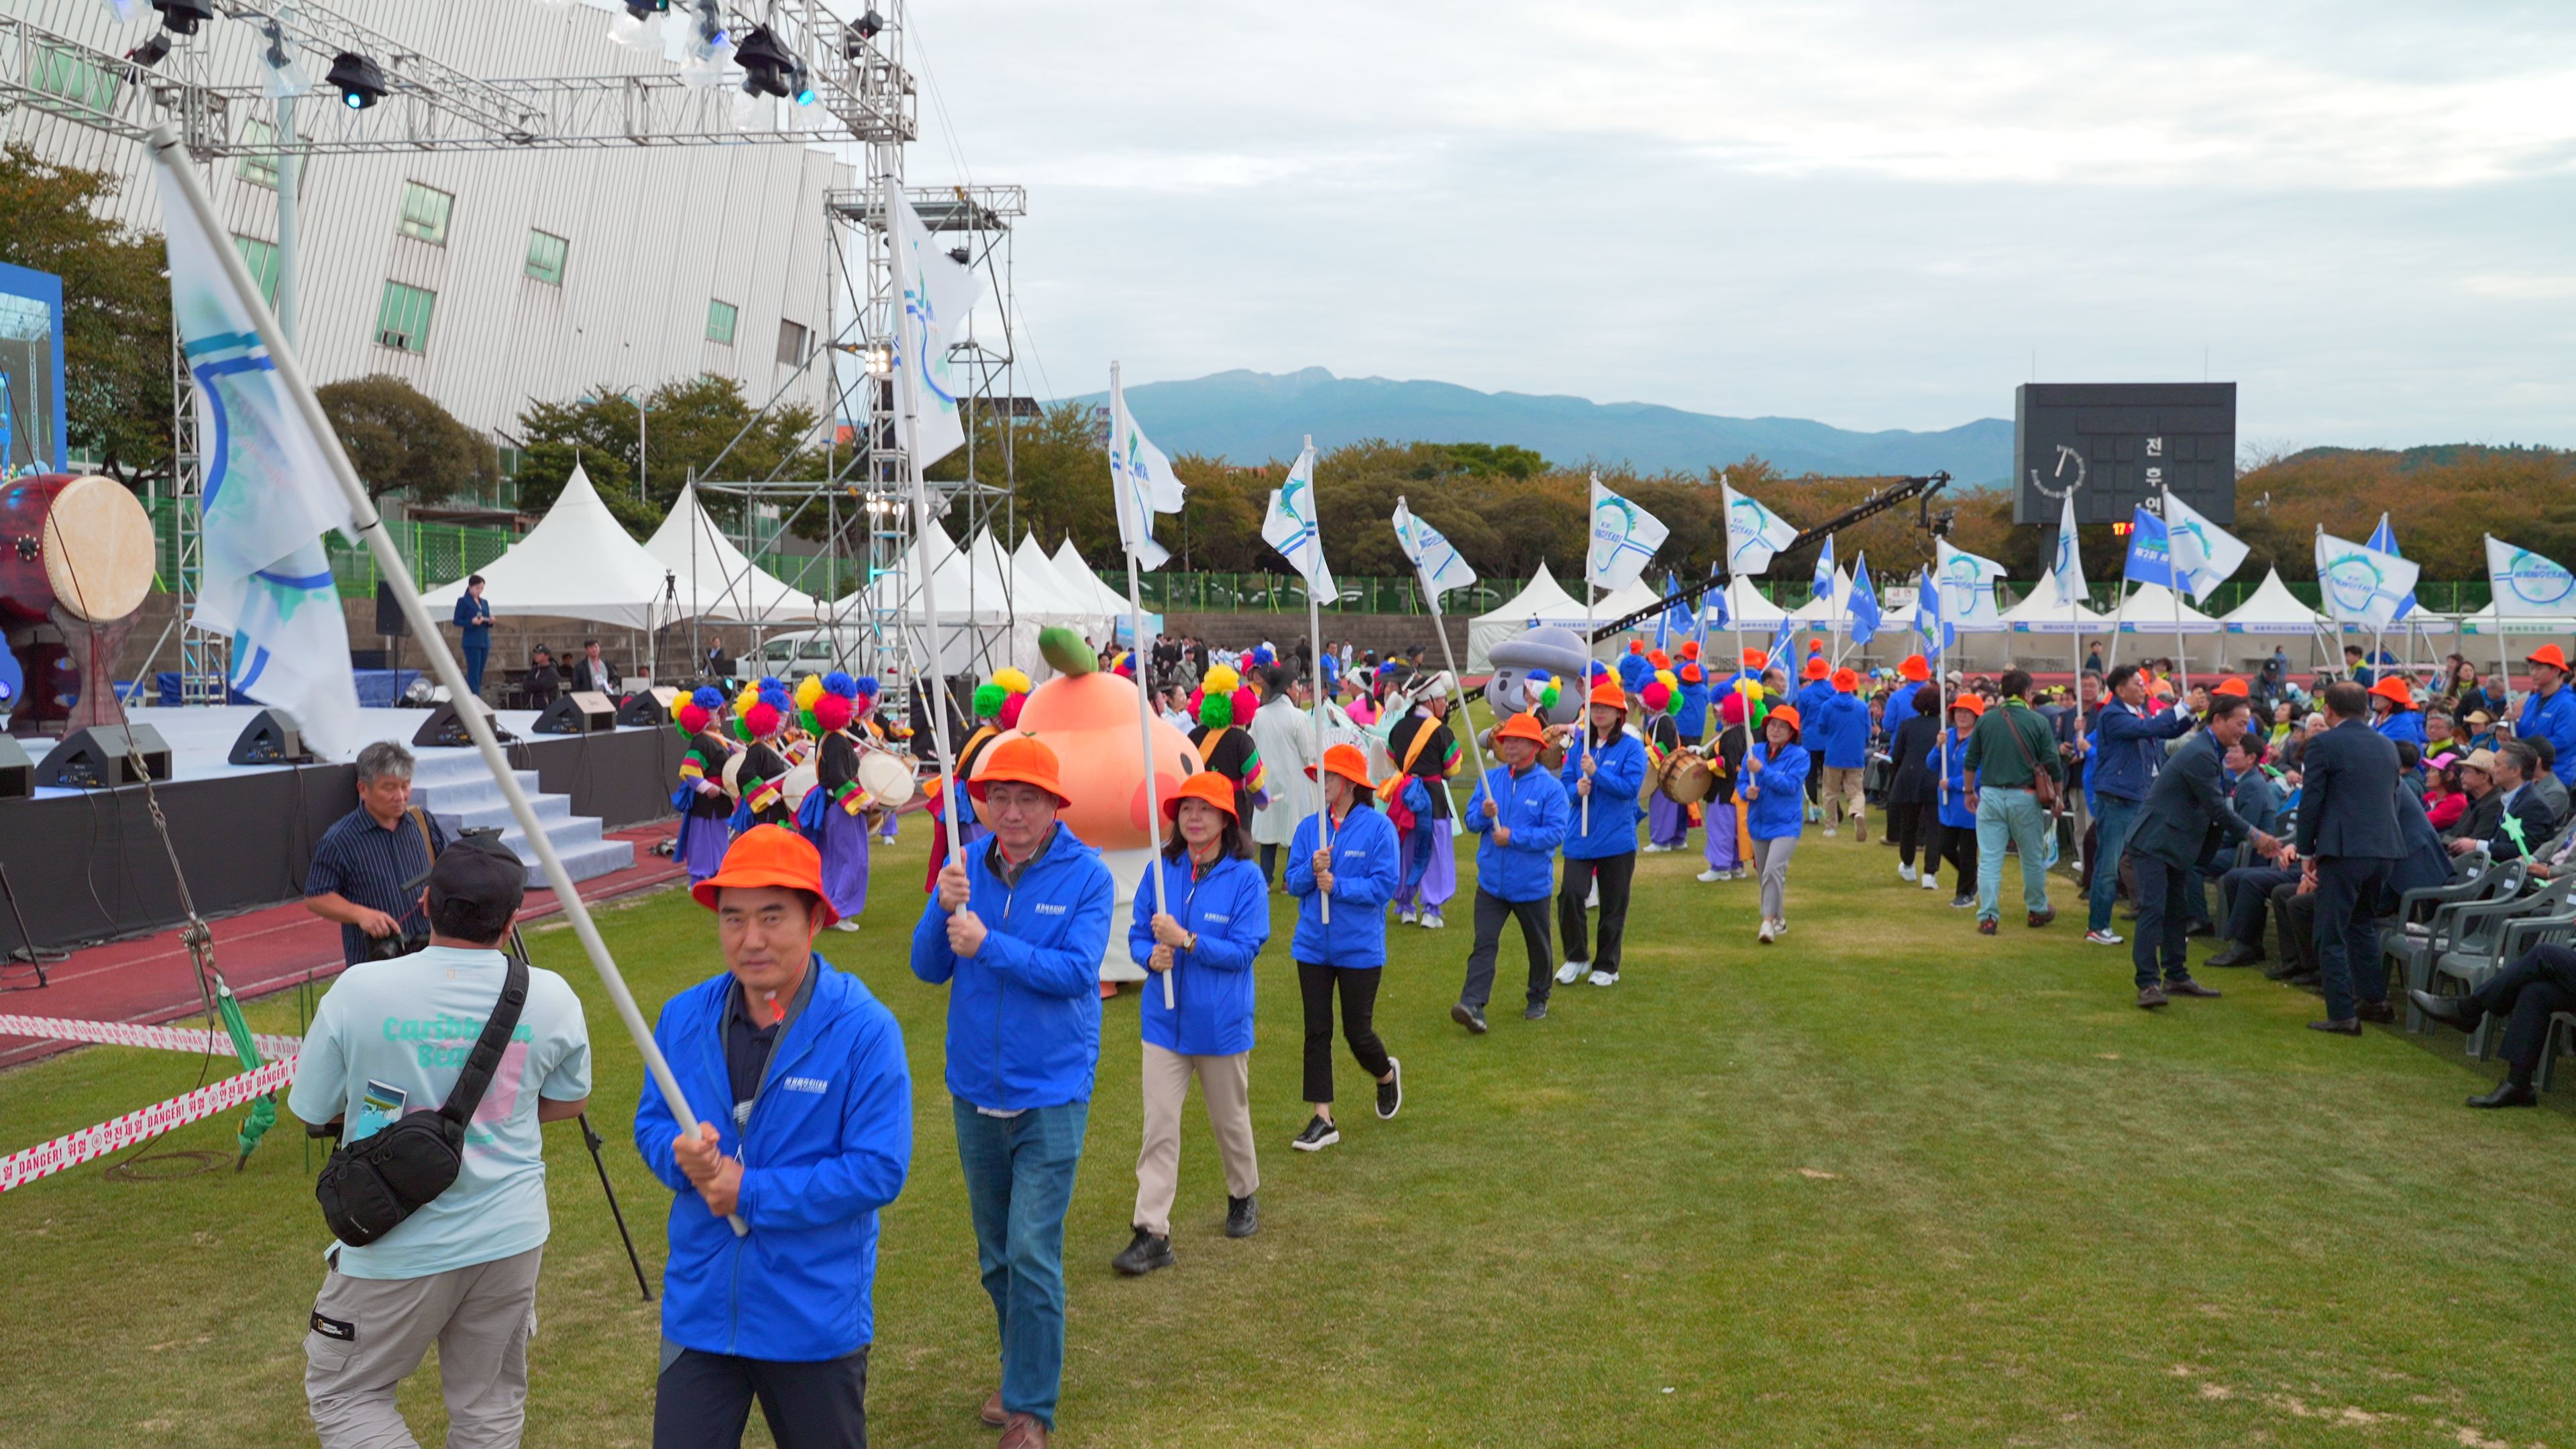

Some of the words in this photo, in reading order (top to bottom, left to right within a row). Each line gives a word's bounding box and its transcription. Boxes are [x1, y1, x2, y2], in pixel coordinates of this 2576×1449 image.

[2146, 437, 2162, 456] 전
[2145, 467, 2162, 487] 후
[382, 1013, 535, 1044] Caribbn
[19, 1146, 62, 1175] DANGER!
[68, 1138, 87, 1158] 위험
[104, 1118, 142, 1144] 안전제일
[148, 1104, 184, 1128] DANGER!
[189, 1096, 205, 1114] 위험
[219, 1079, 252, 1102] 안전제일
[257, 1066, 288, 1087] DANGER!
